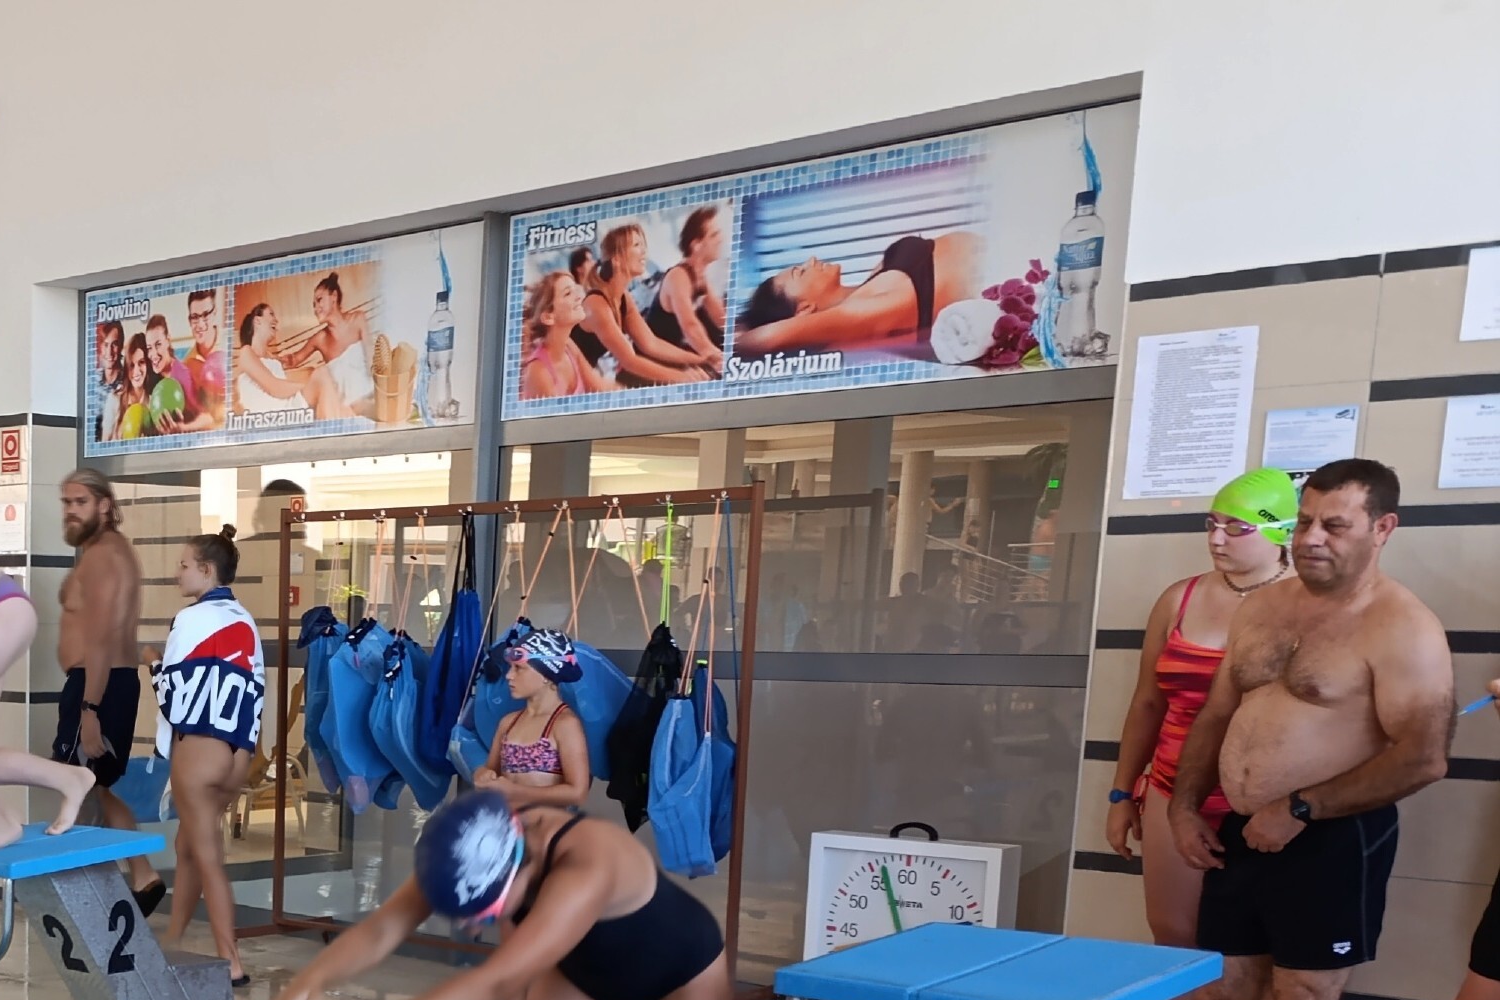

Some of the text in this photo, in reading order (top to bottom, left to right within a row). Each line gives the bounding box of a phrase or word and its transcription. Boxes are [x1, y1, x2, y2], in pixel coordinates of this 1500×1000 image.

[527, 221, 597, 250] Fitness
[97, 299, 150, 322] Bowling
[725, 350, 843, 384] Szolárium
[227, 409, 315, 432] Infraszauna
[898, 869, 917, 885] 60
[930, 881, 941, 896] 5
[849, 894, 868, 909] 50
[948, 905, 964, 920] 10
[108, 899, 135, 974] 2
[840, 923, 858, 938] 45
[43, 914, 90, 973] 2
